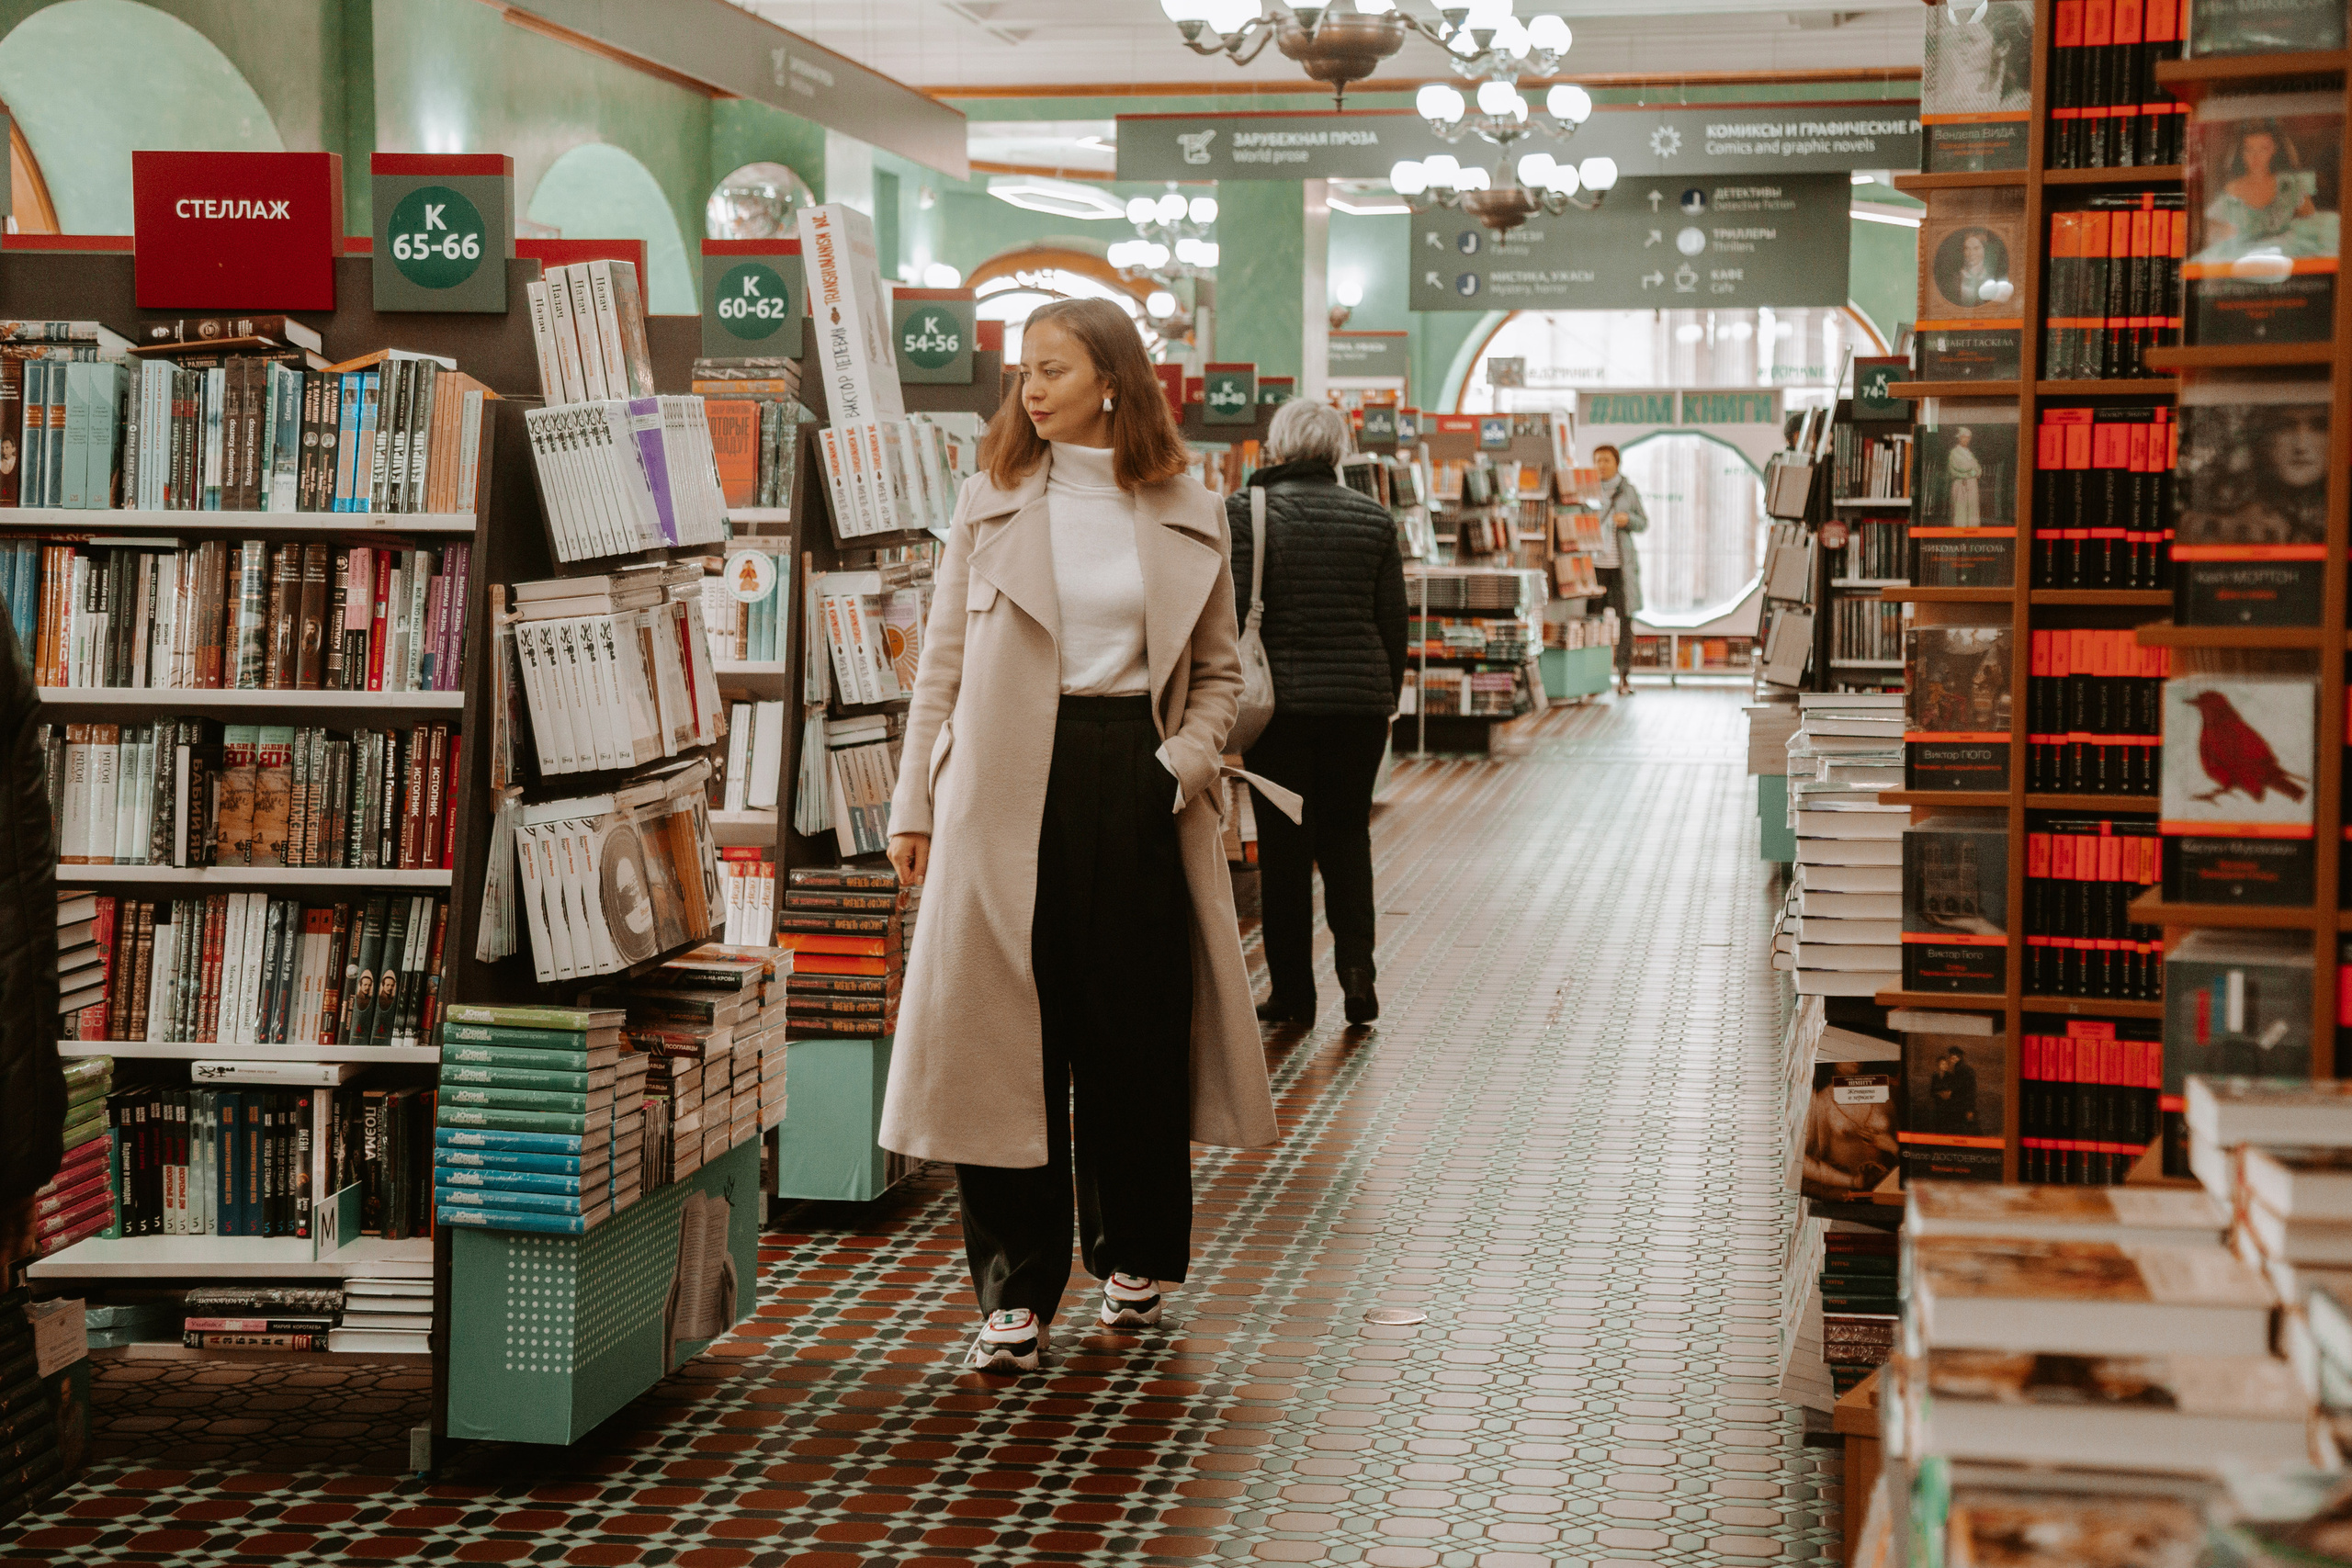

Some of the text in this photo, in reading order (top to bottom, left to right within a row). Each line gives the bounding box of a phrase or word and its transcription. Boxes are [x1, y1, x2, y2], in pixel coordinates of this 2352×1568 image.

[1232, 130, 1378, 148] ЗАРУБЕЖНАЯ ПРОЗА
[1705, 123, 1782, 139] КОМИКСЫ
[1785, 123, 1798, 137] И
[1800, 119, 1907, 137] ГРАФИЧЕСКИЕ
[1934, 128, 2016, 140] Вендела ВИДА
[1705, 138, 1876, 156] Comics and graphic novels
[175, 198, 290, 220] СТЕЛЛАЖ
[424, 204, 447, 231] К
[392, 233, 481, 260] 65-66
[816, 232, 842, 306] TRANSHUMANISM
[552, 284, 563, 318] Палач
[575, 280, 586, 314] Палач
[596, 276, 607, 311] Палач
[743, 276, 761, 297] К
[536, 299, 546, 333] Палач
[718, 299, 785, 320] 60-62
[924, 317, 939, 334] К
[831, 327, 852, 371] ПЕЛЕВИН
[904, 334, 958, 352] 54-56
[329, 389, 337, 424] КАРАМЗИН
[1589, 393, 1772, 423] #ДОМ КНИГИ
[247, 418, 255, 447] Кантор
[1970, 543, 2006, 553] ГОГОЛЬ
[101, 569, 109, 595] мужика
[457, 576, 465, 606] ВЫБИРАЯ
[440, 576, 450, 632] ВЫБИРАЯ ЖИЗНЬ
[334, 610, 344, 649] КАРАМЗИН
[413, 618, 420, 628] МЫ
[344, 655, 352, 684] КОРОТАЕВА
[409, 649, 417, 678] СКАЖЕМ
[74, 750, 85, 784] ВОДЫ
[1924, 750, 1992, 761] Виктор ГЮГО
[383, 740, 395, 829] Летучий Голландец
[411, 767, 422, 817] ИСТОПНИК
[429, 766, 440, 817] ИСТОПНИК
[287, 784, 306, 864] ПРОМЕЖУТОК
[304, 784, 322, 863] ПРОМЕЖУТОК
[189, 829, 200, 862] ЯР
[352, 920, 362, 958] ЛЕРМОНТОВ
[1928, 949, 1961, 960] Виктор
[201, 962, 211, 996] Варшава,
[209, 962, 221, 1032] Варшава, Элохим!
[664, 1043, 698, 1052] ПСОГЛАВЦЫ
[299, 1129, 309, 1151] ОКЕАН
[365, 1106, 377, 1161] ПОЭМА
[122, 1143, 131, 1170] Падение
[265, 1158, 271, 1167] ДО
[1931, 1152, 2002, 1164] ДОСТОЕВСКИЙ
[122, 1178, 130, 1205] колодец
